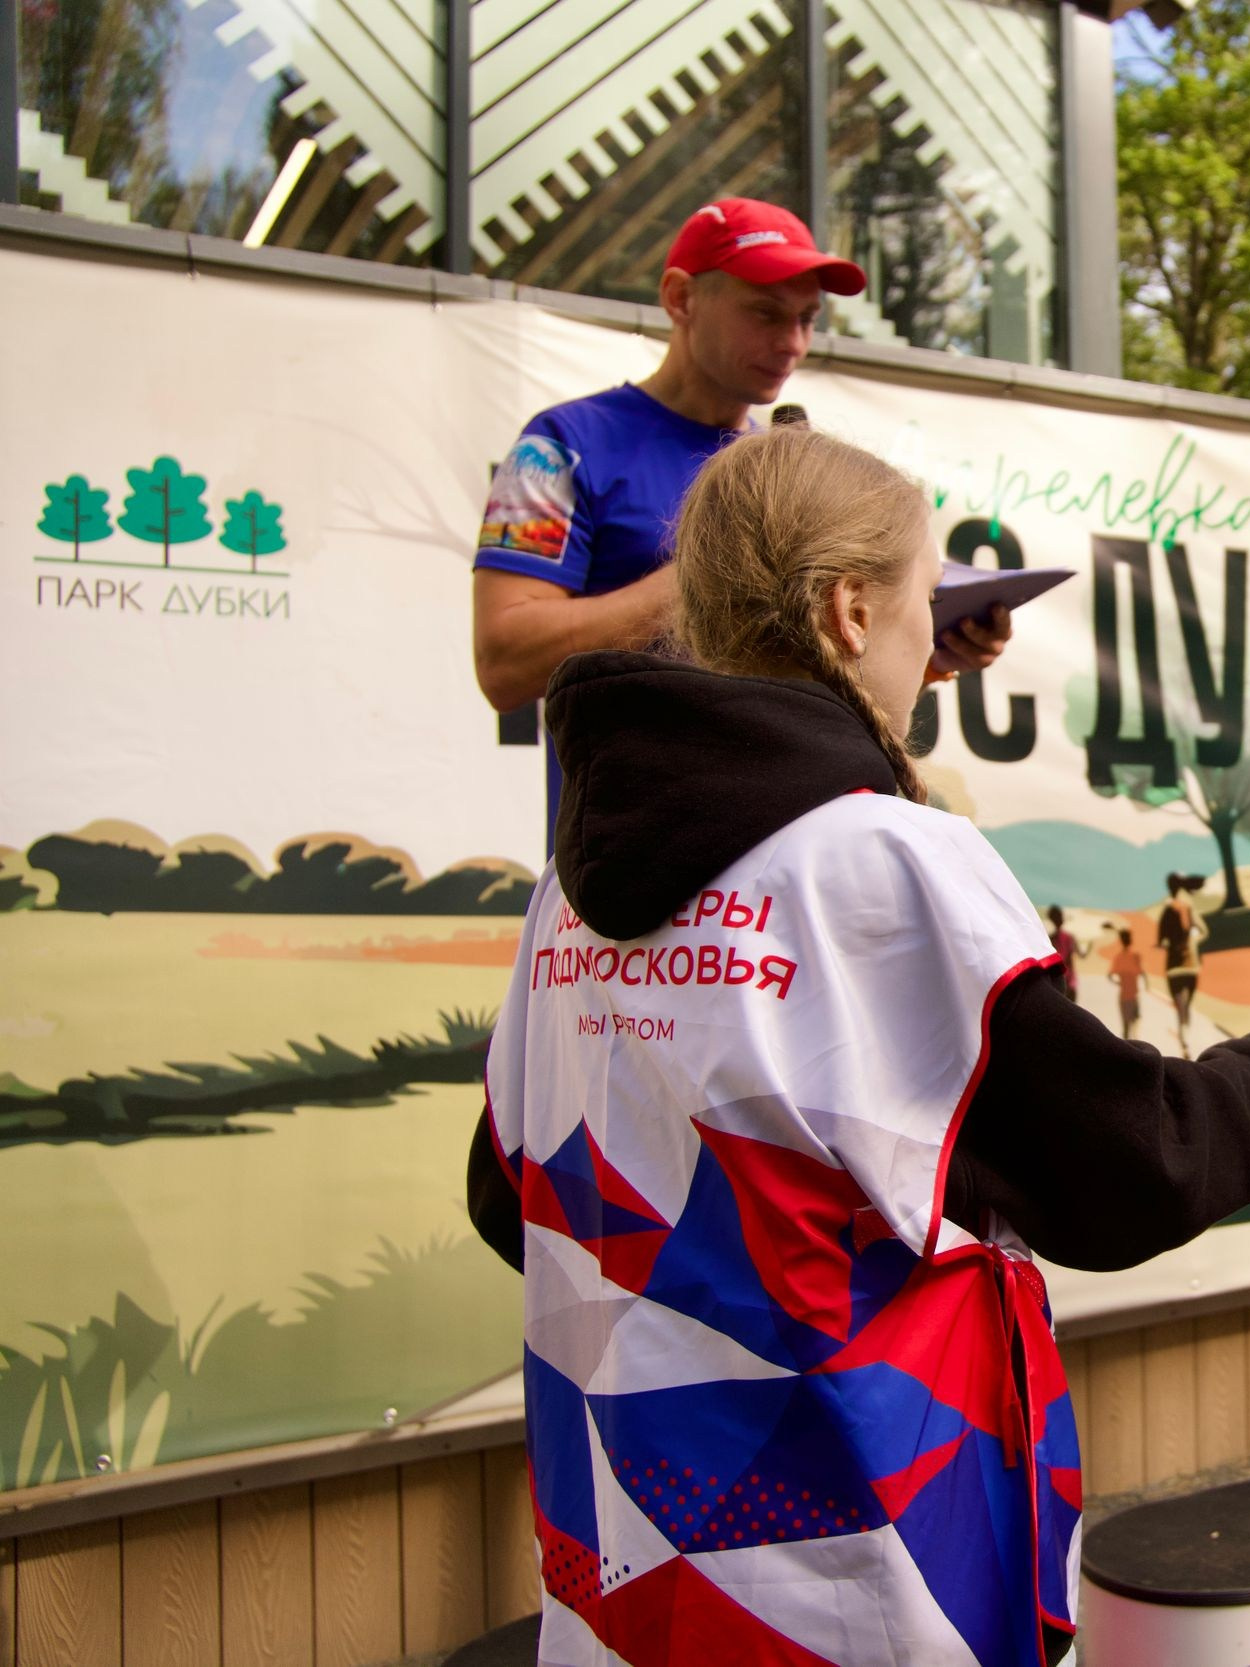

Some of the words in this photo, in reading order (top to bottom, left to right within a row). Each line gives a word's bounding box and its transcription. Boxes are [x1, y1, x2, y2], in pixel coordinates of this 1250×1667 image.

[36, 575, 143, 612] ПАРК
[161, 583, 291, 619] ДУБКИ
[532, 944, 798, 1001] ПОДМОСКОВЬЯ
[578, 1013, 606, 1036] МЫ
